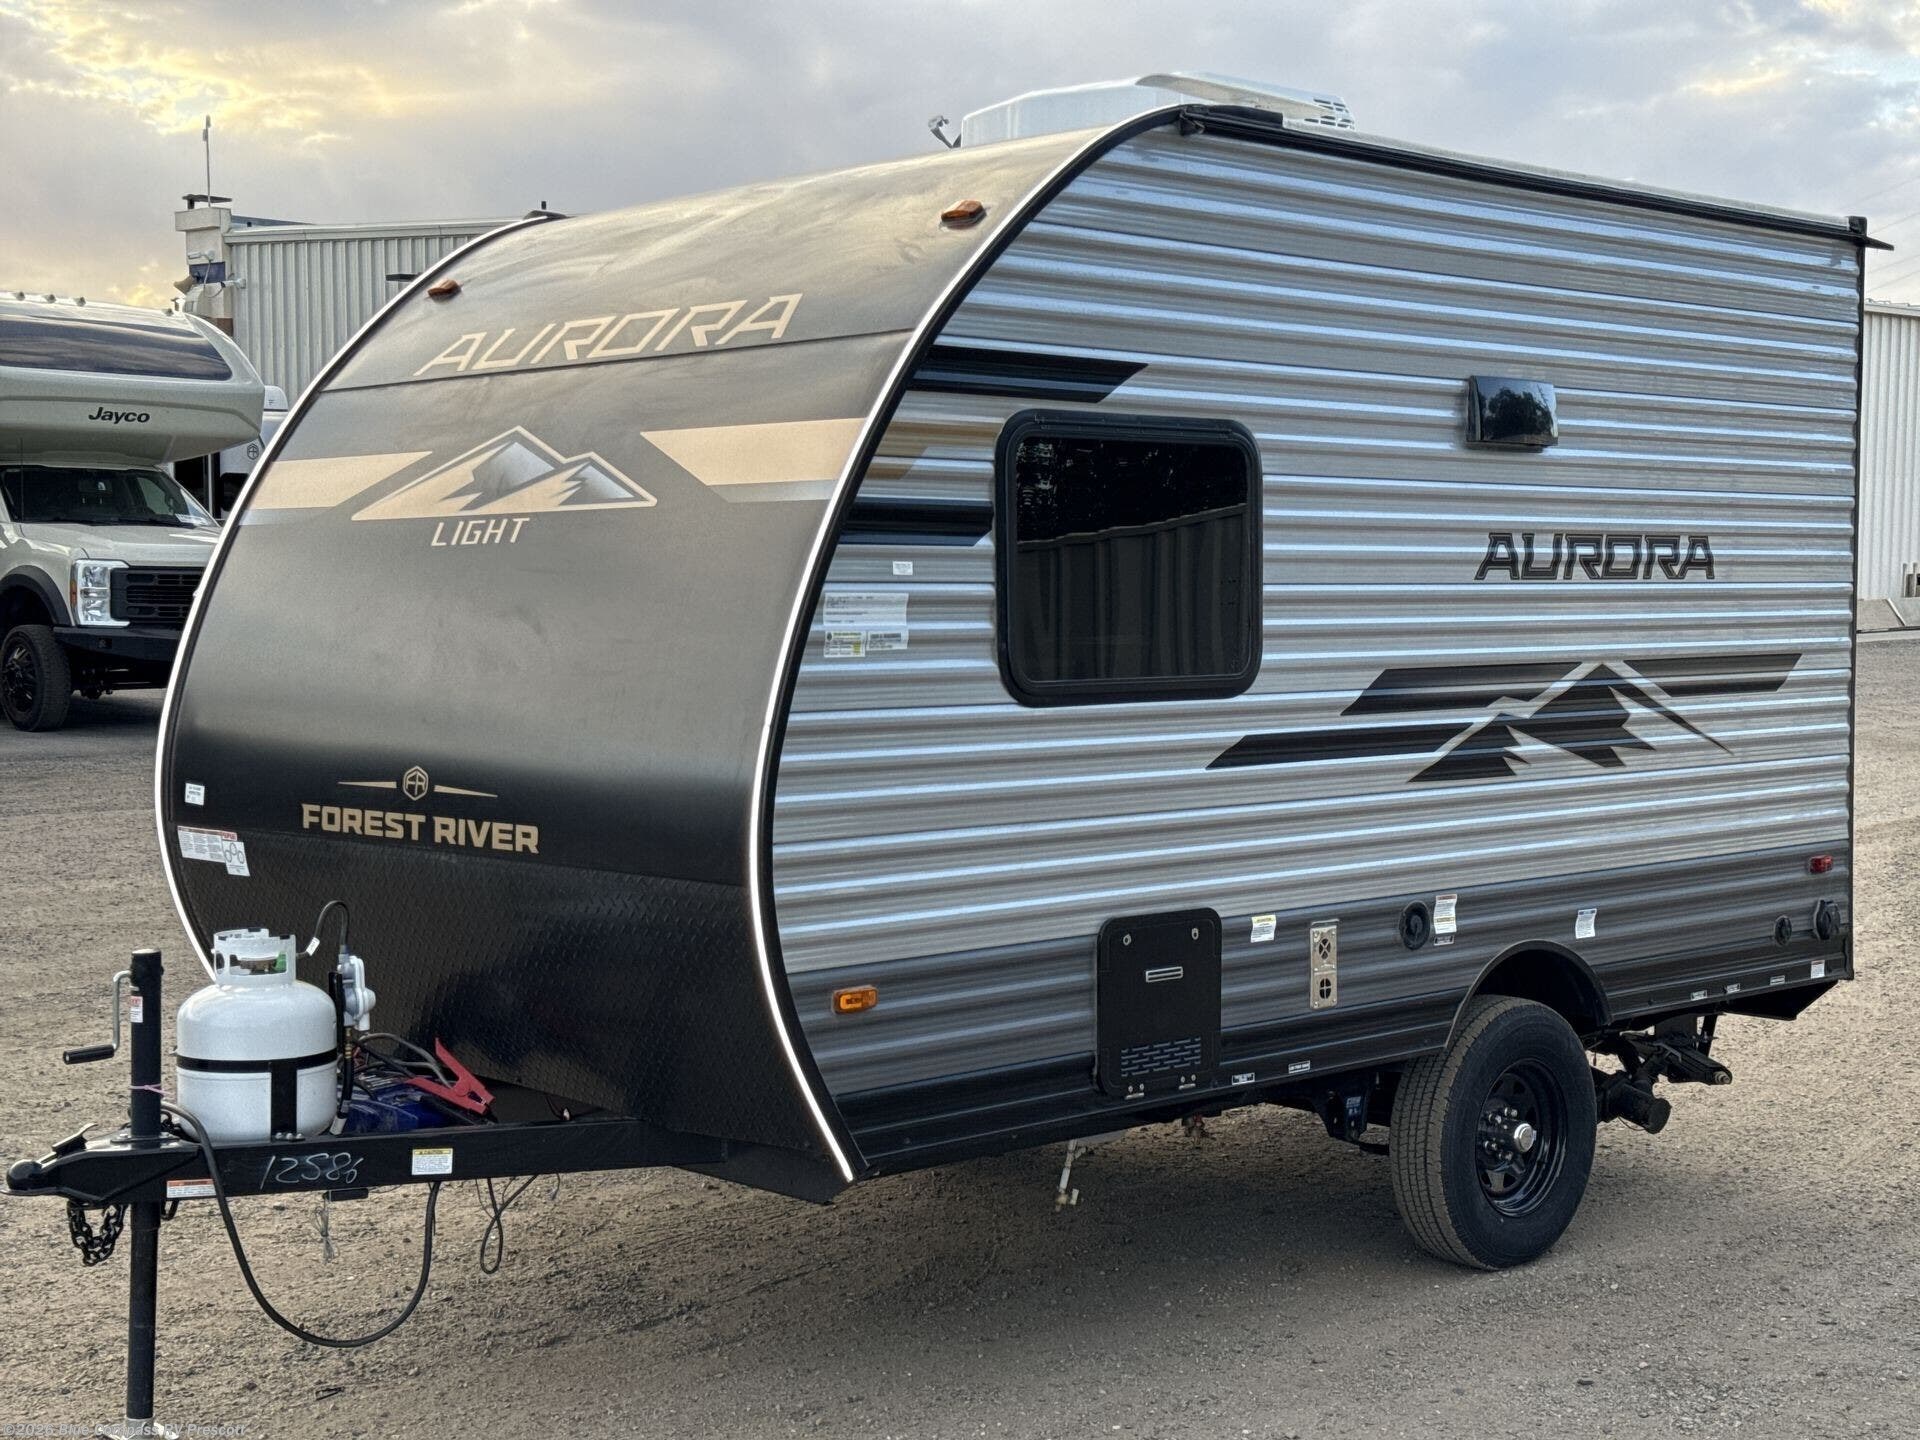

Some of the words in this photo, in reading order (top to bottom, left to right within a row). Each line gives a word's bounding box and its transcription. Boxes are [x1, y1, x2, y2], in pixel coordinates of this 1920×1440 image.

[413, 293, 803, 377] AURORA
[88, 407, 151, 425] Jayco
[430, 517, 531, 547] LIGHT
[1474, 532, 1716, 581] AURORA
[301, 803, 427, 841] FOREST
[432, 816, 540, 854] RIVER
